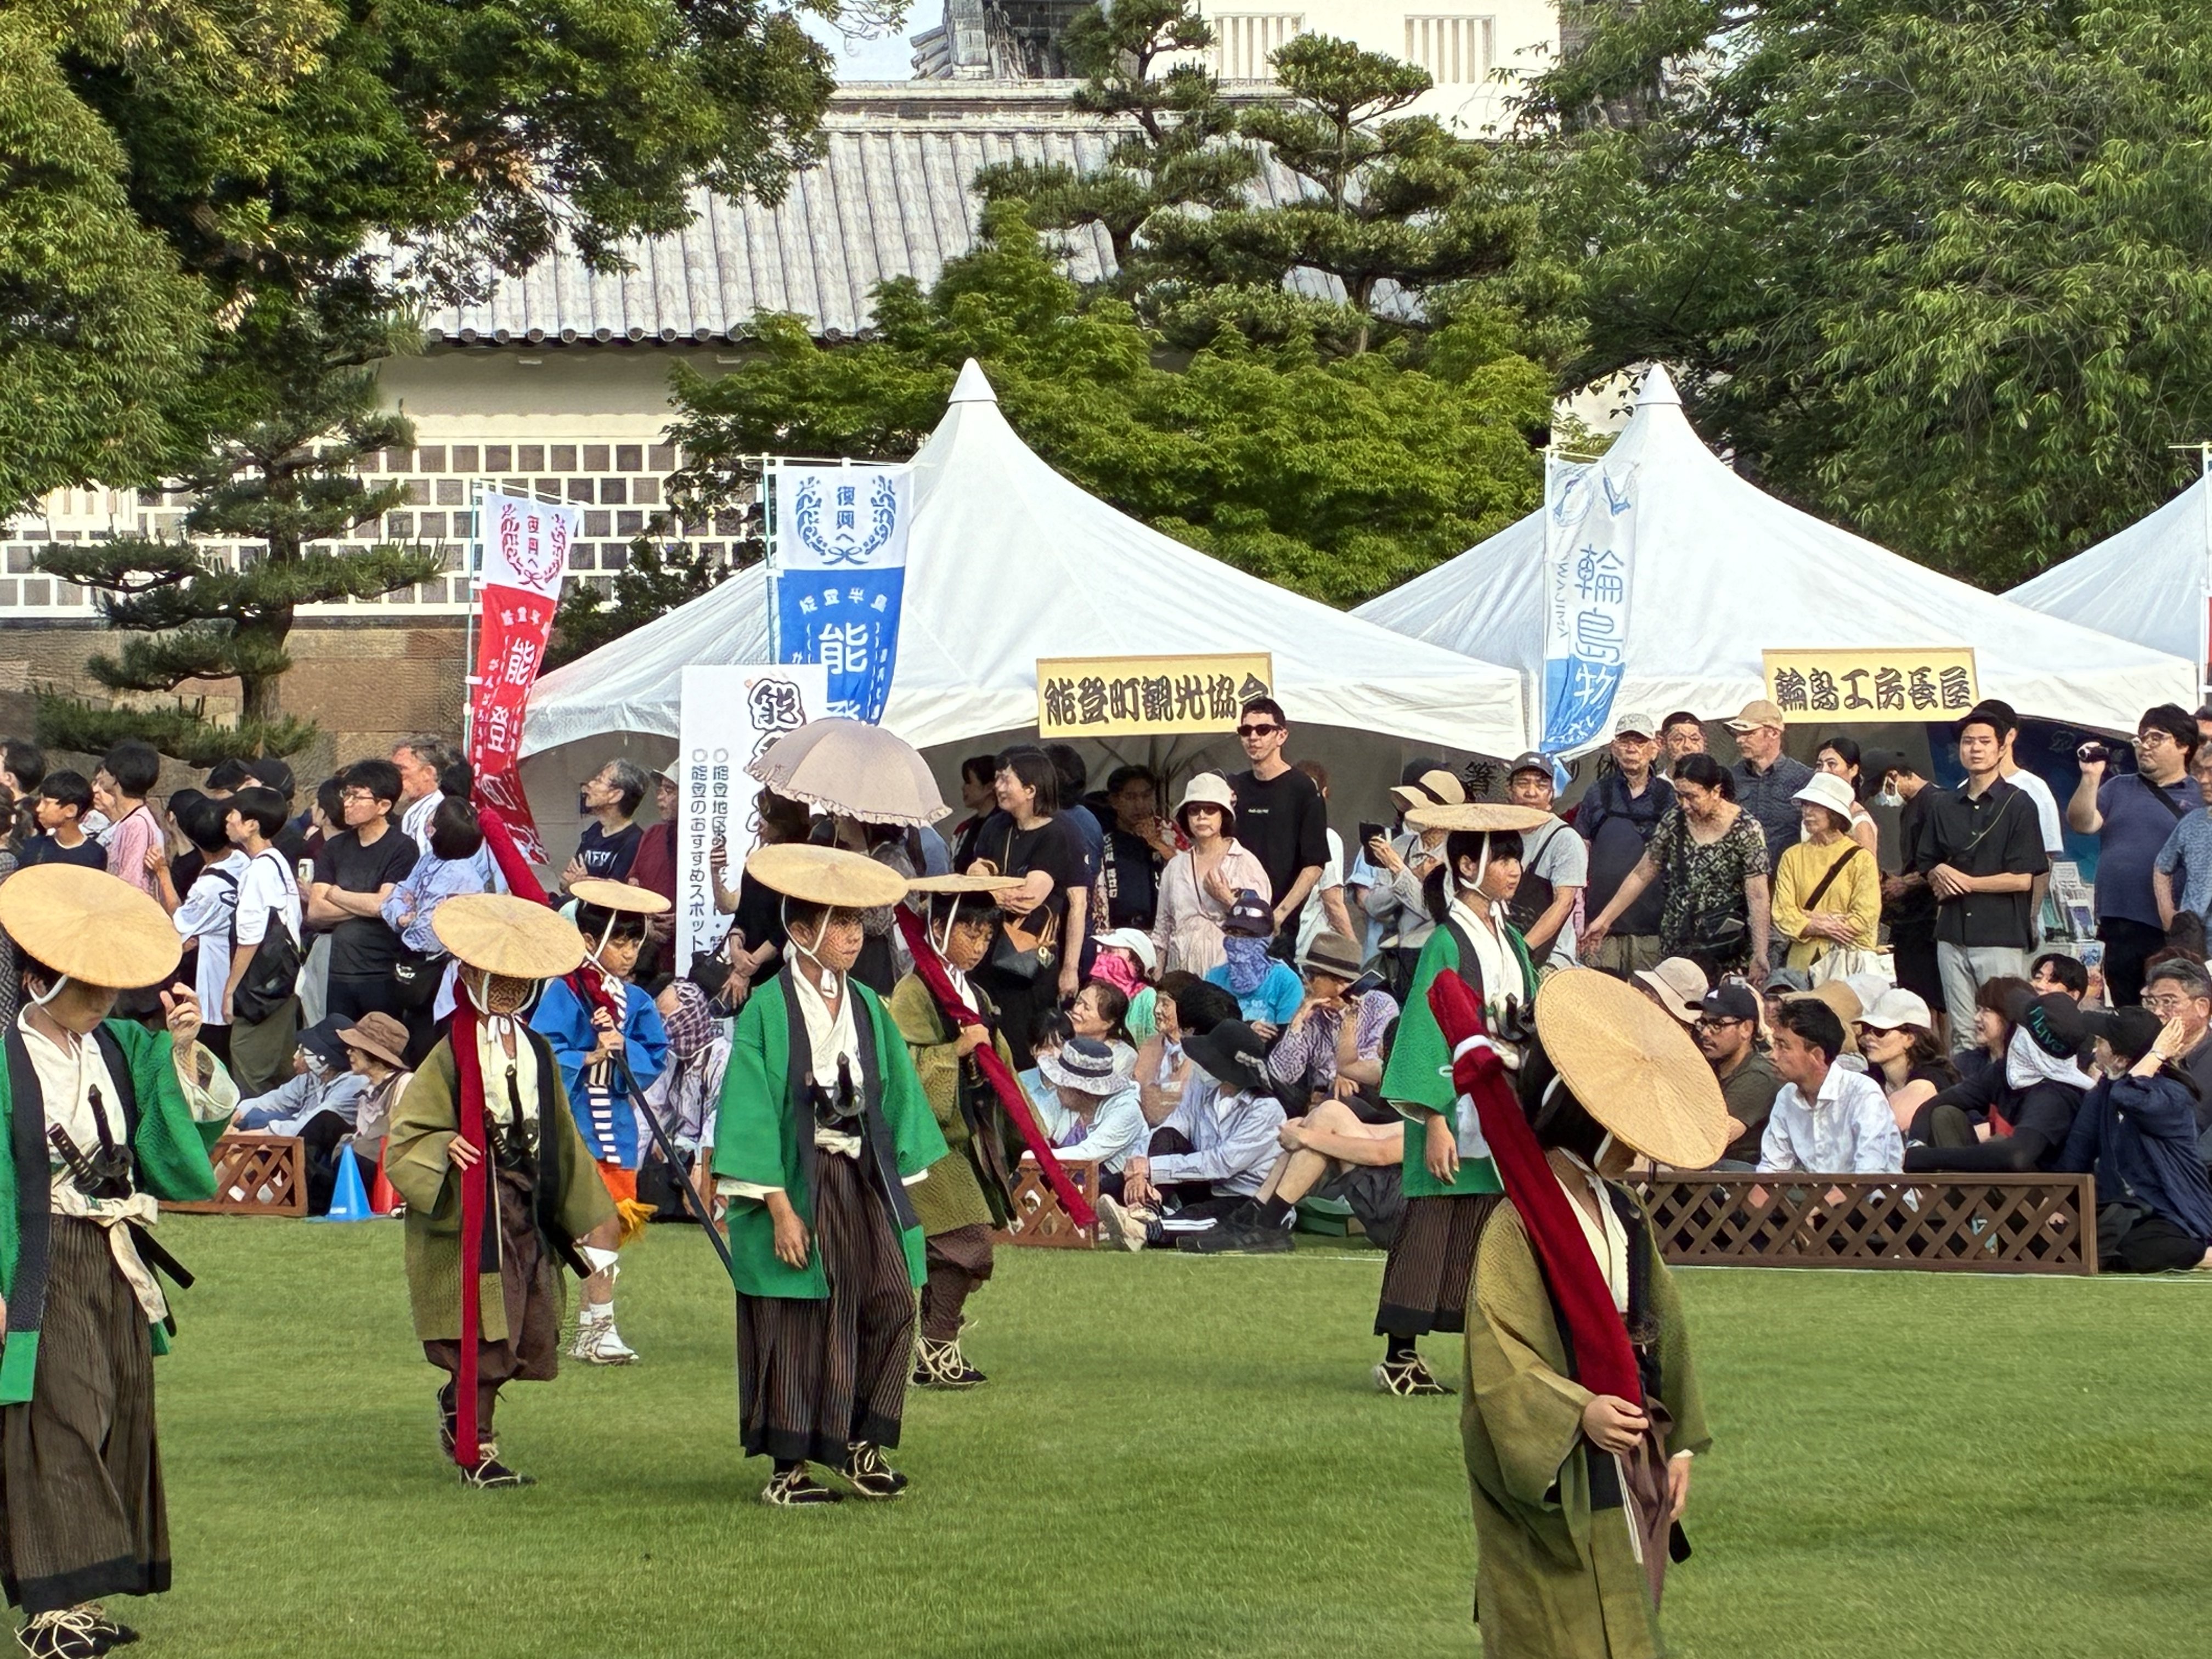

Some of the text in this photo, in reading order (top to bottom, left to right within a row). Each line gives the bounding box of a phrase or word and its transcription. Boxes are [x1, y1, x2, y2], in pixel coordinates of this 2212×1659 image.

[836, 486, 855, 543] 復興へ
[1554, 563, 1570, 639] WAJIMA
[1774, 666, 1973, 712] 輪島工房長屋
